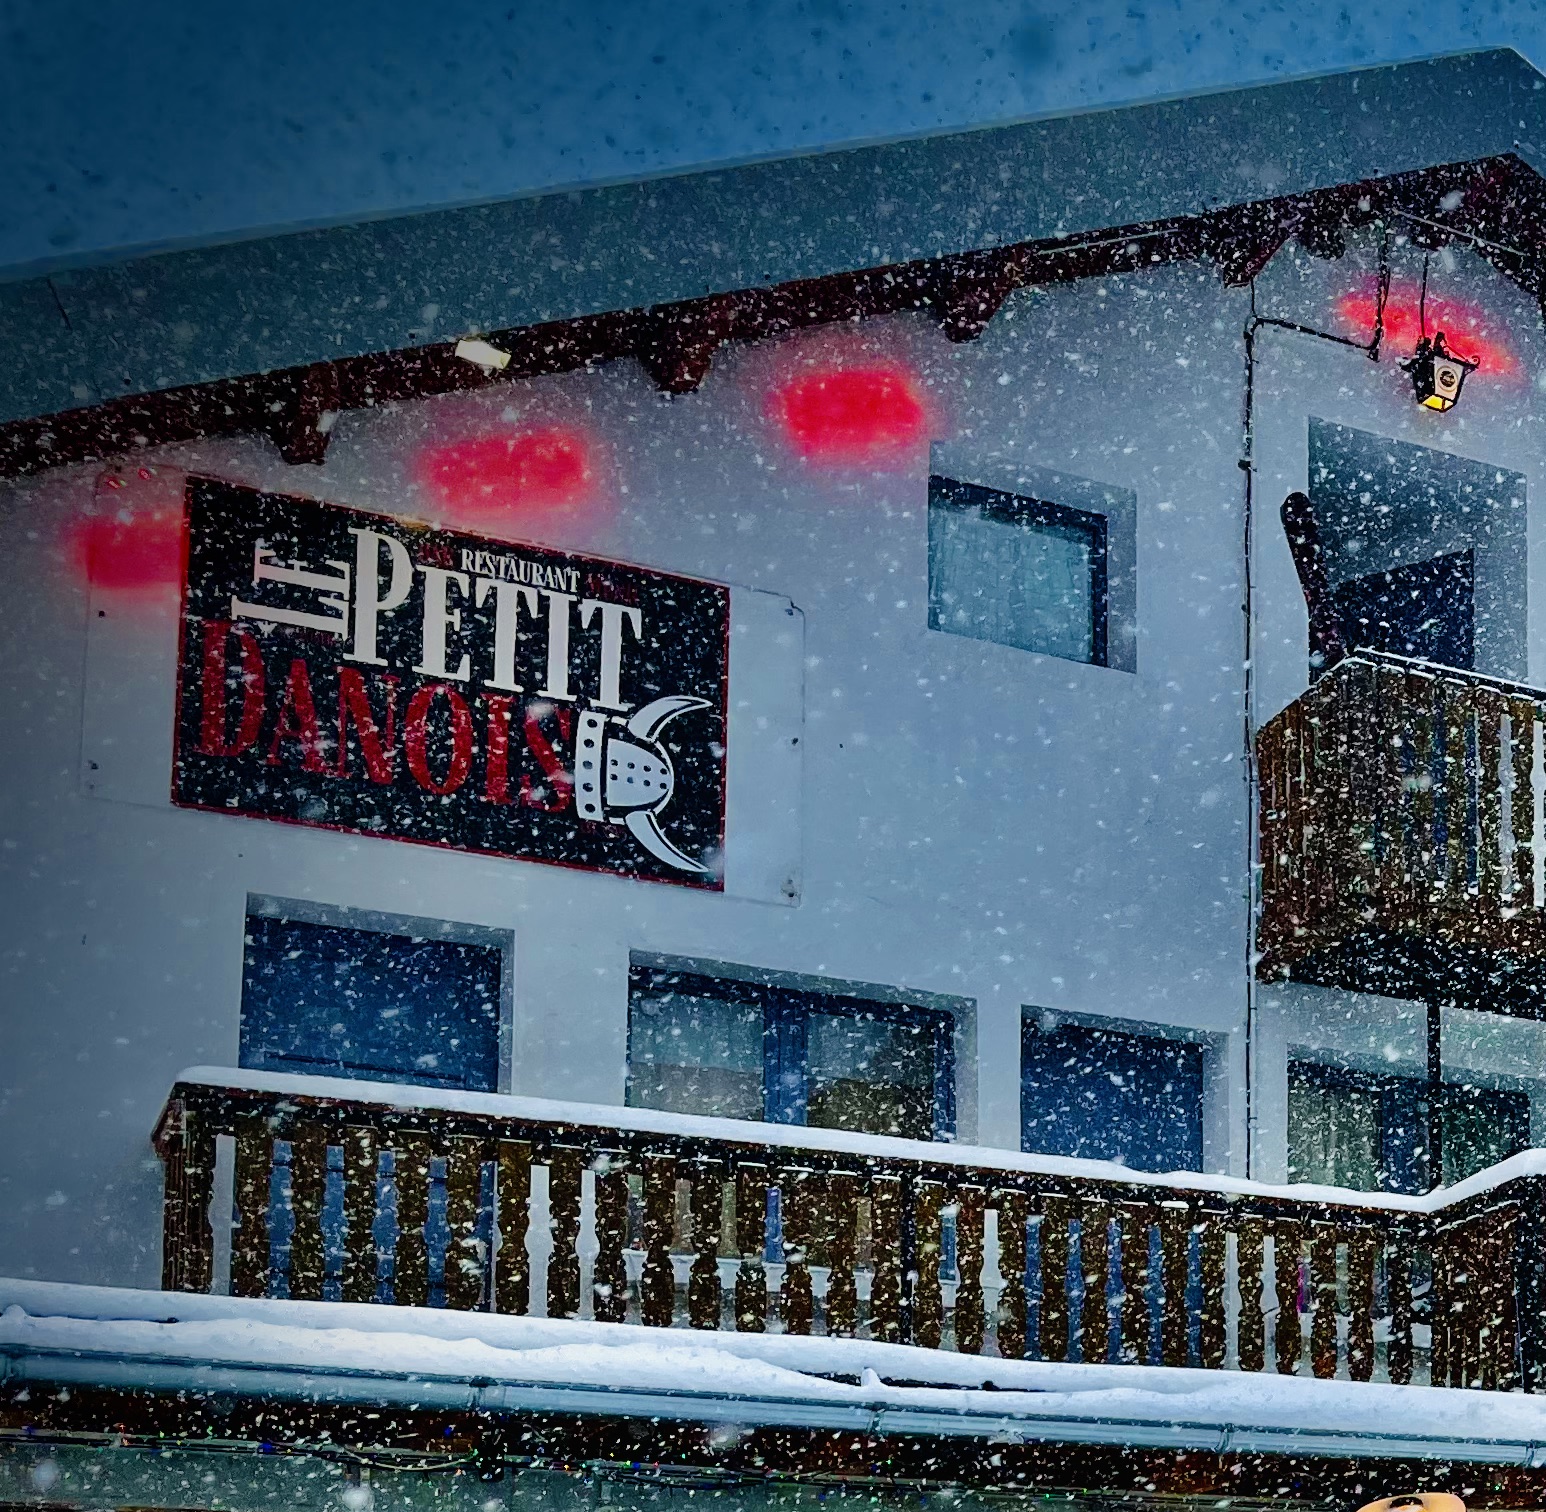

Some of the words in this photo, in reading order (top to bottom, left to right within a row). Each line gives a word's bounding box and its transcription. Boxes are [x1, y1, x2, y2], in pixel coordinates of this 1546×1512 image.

[231, 540, 350, 641] LE
[344, 527, 643, 712] PETIT
[460, 548, 580, 593] RESTAURANT
[193, 618, 575, 813] DANOIS
